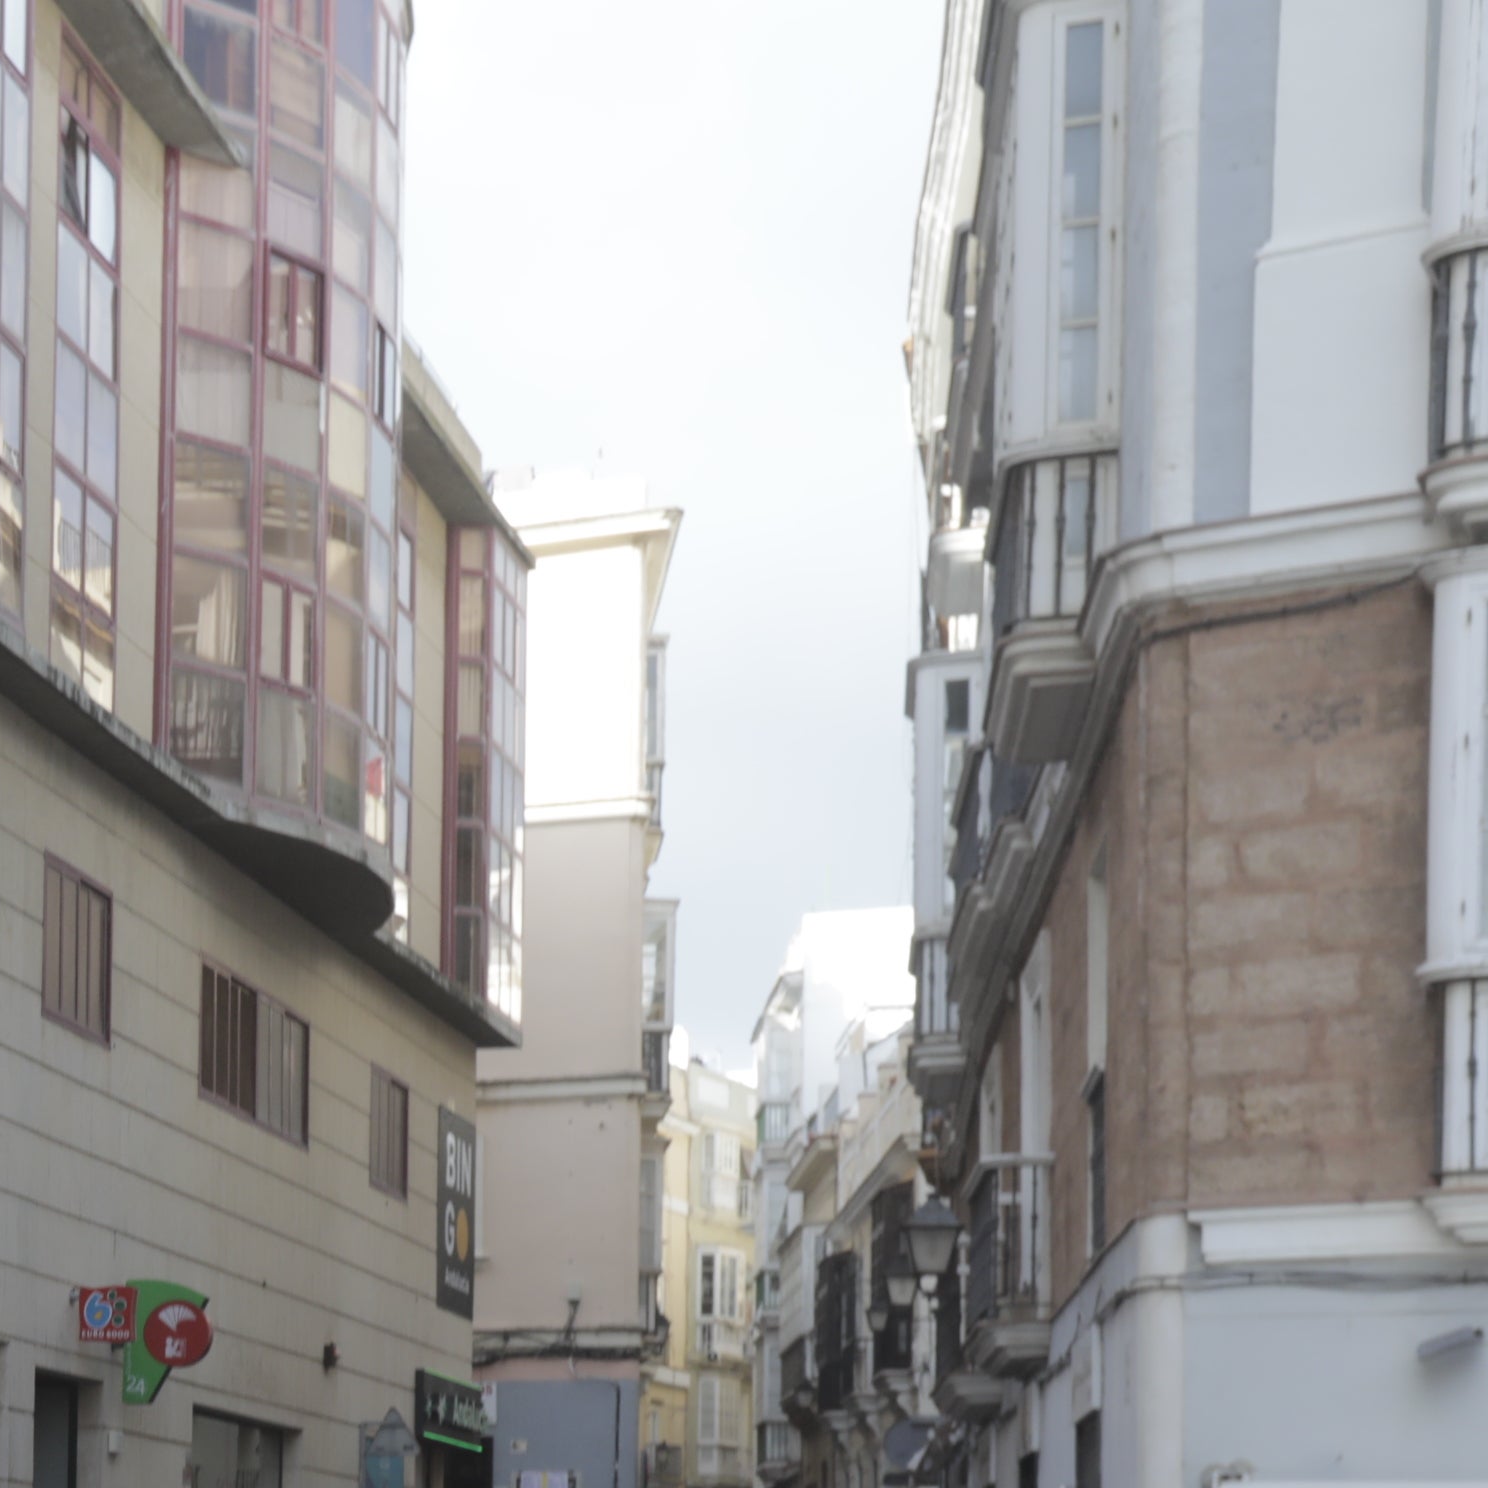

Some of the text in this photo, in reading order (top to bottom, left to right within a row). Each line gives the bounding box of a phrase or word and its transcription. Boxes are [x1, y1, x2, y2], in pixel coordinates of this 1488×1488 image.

[445, 1131, 472, 1198] BIN
[81, 1328, 130, 1340] EURO 6000
